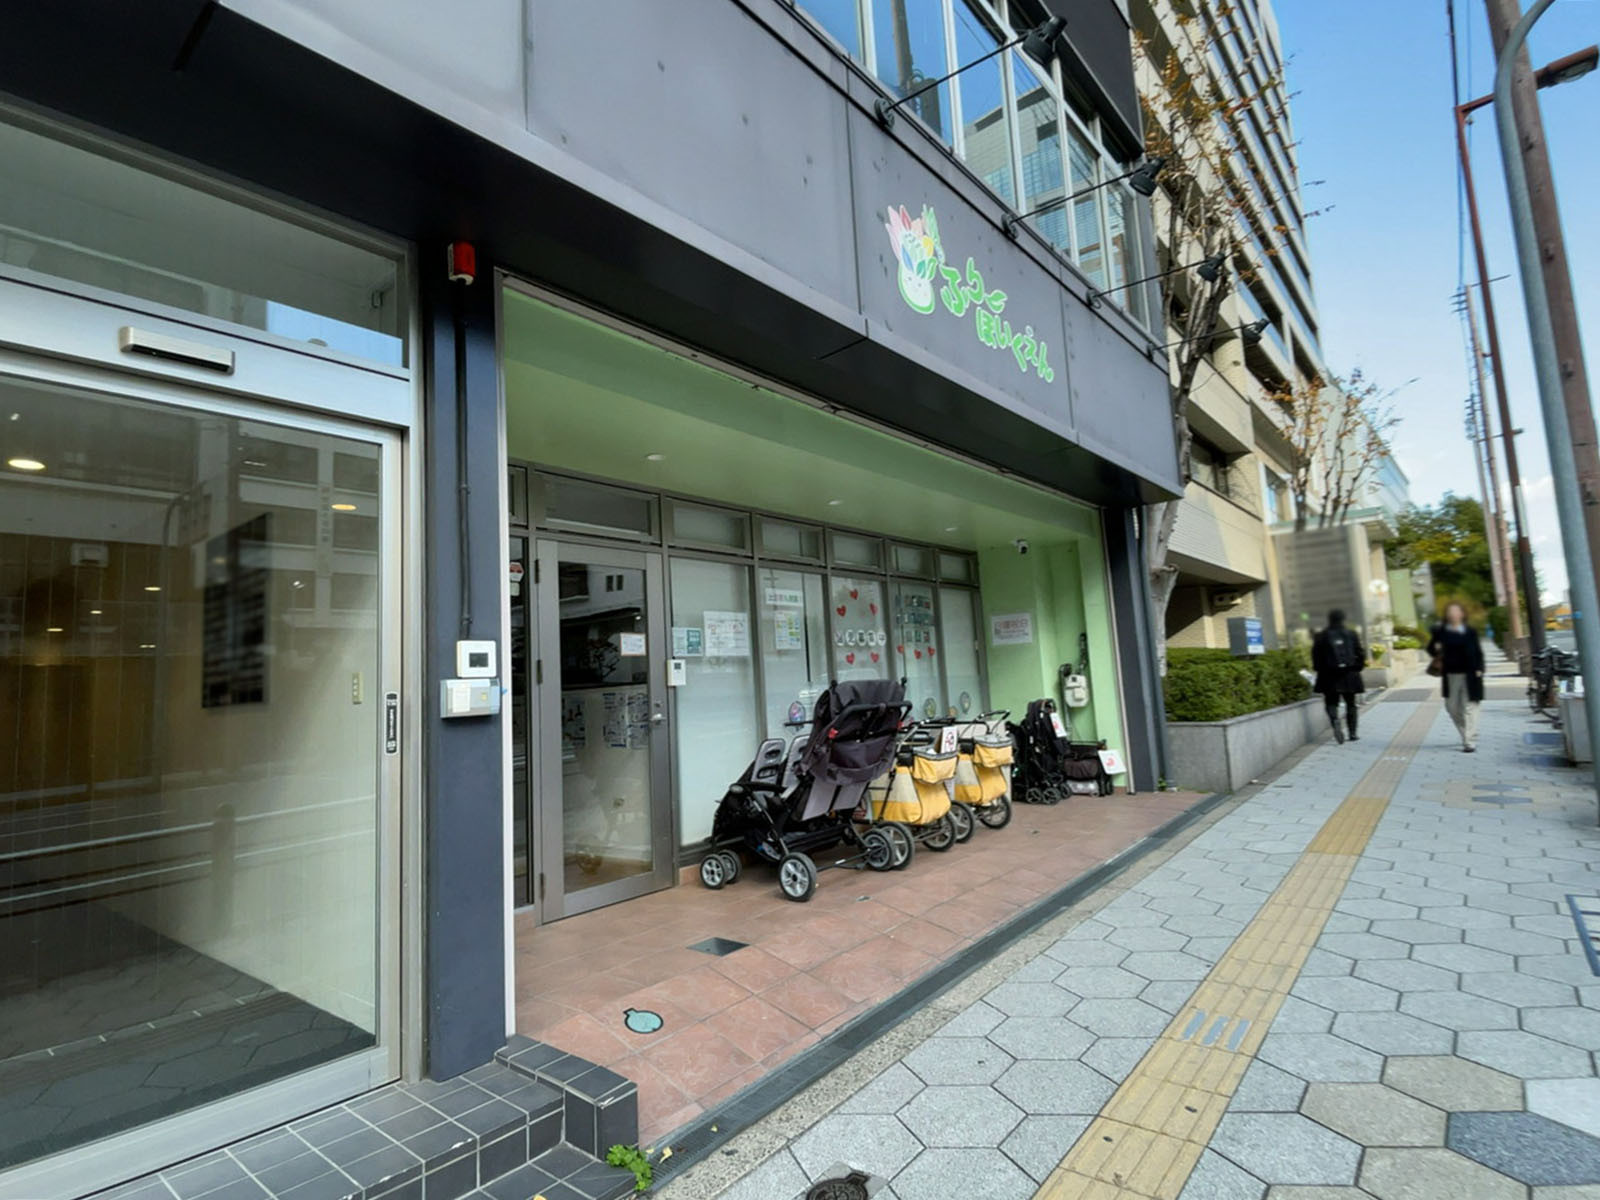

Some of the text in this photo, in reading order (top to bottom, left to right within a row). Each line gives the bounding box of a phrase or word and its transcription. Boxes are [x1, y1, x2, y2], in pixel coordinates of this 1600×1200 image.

[976, 307, 1055, 383] ほいくえん
